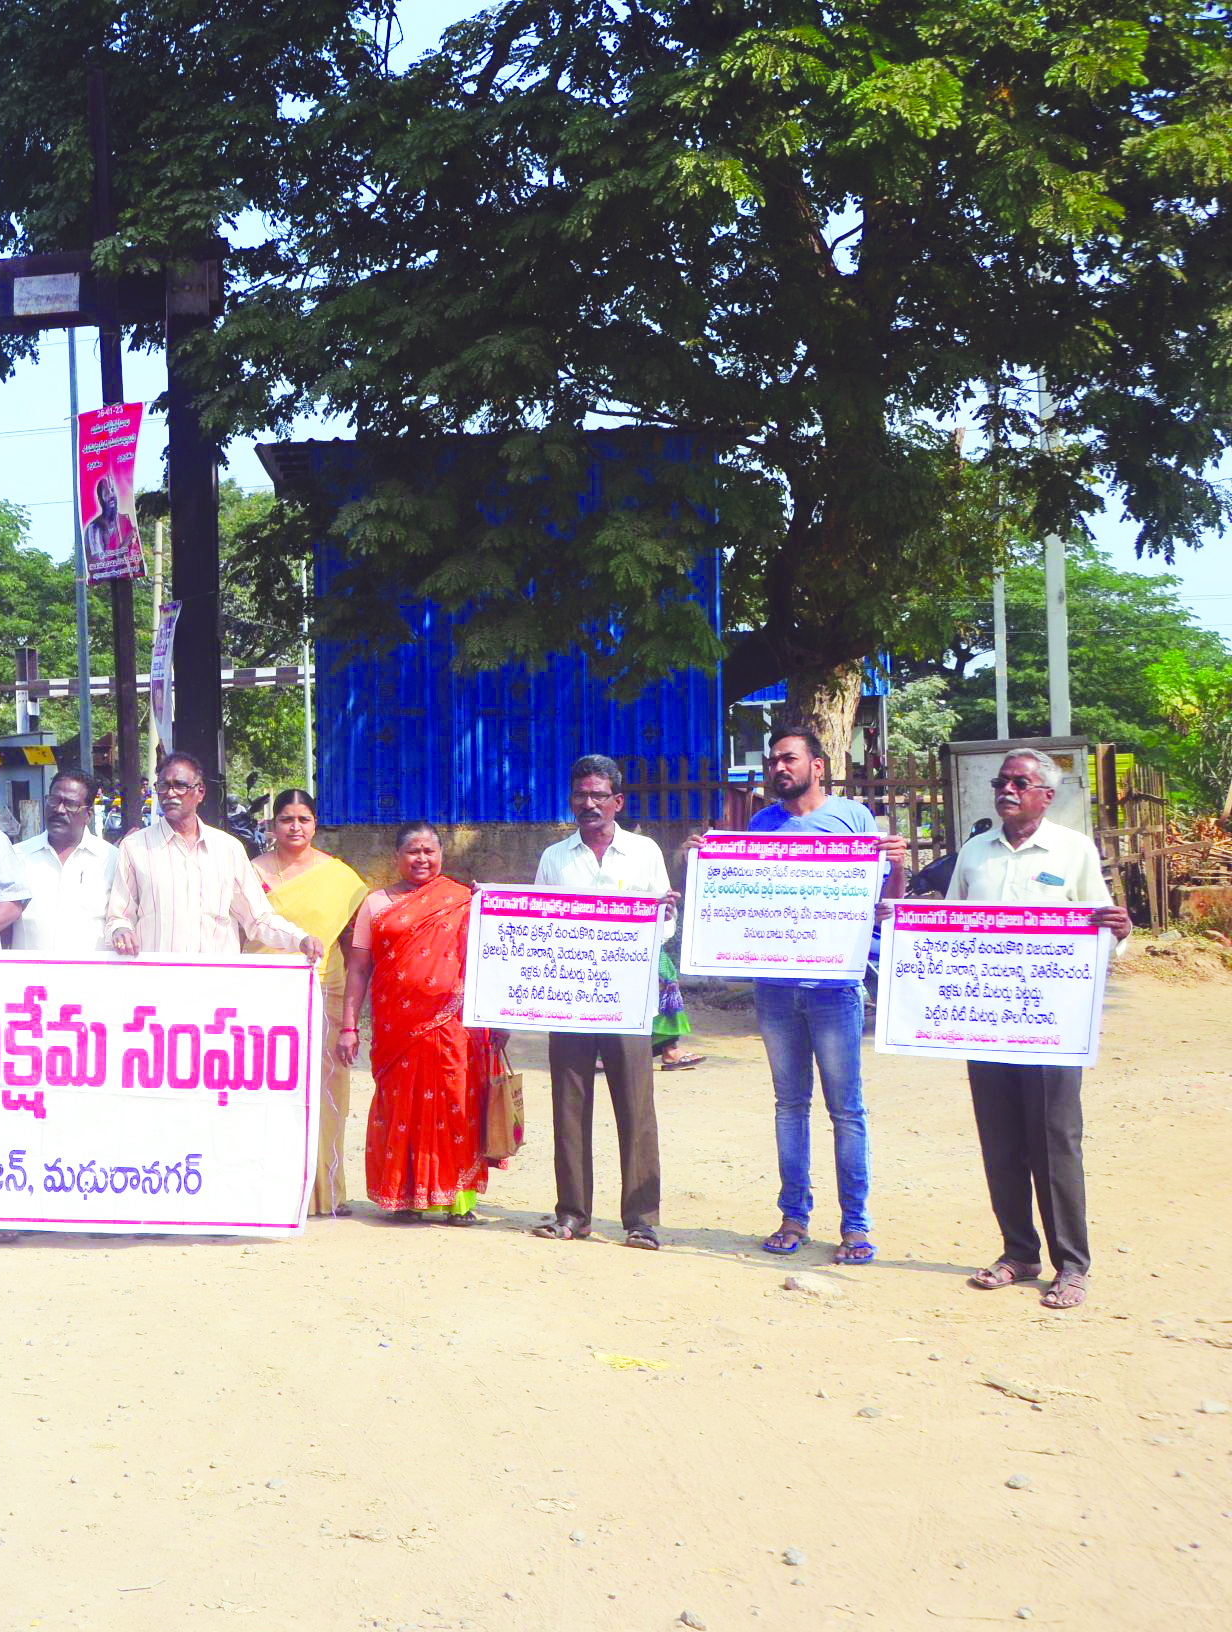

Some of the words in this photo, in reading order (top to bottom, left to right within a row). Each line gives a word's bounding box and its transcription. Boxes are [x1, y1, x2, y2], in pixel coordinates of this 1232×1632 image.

[596, 930, 639, 942] విజయవాడ
[121, 1005, 299, 1106] సంఘం
[43, 1153, 203, 1200] మధురానగర్
